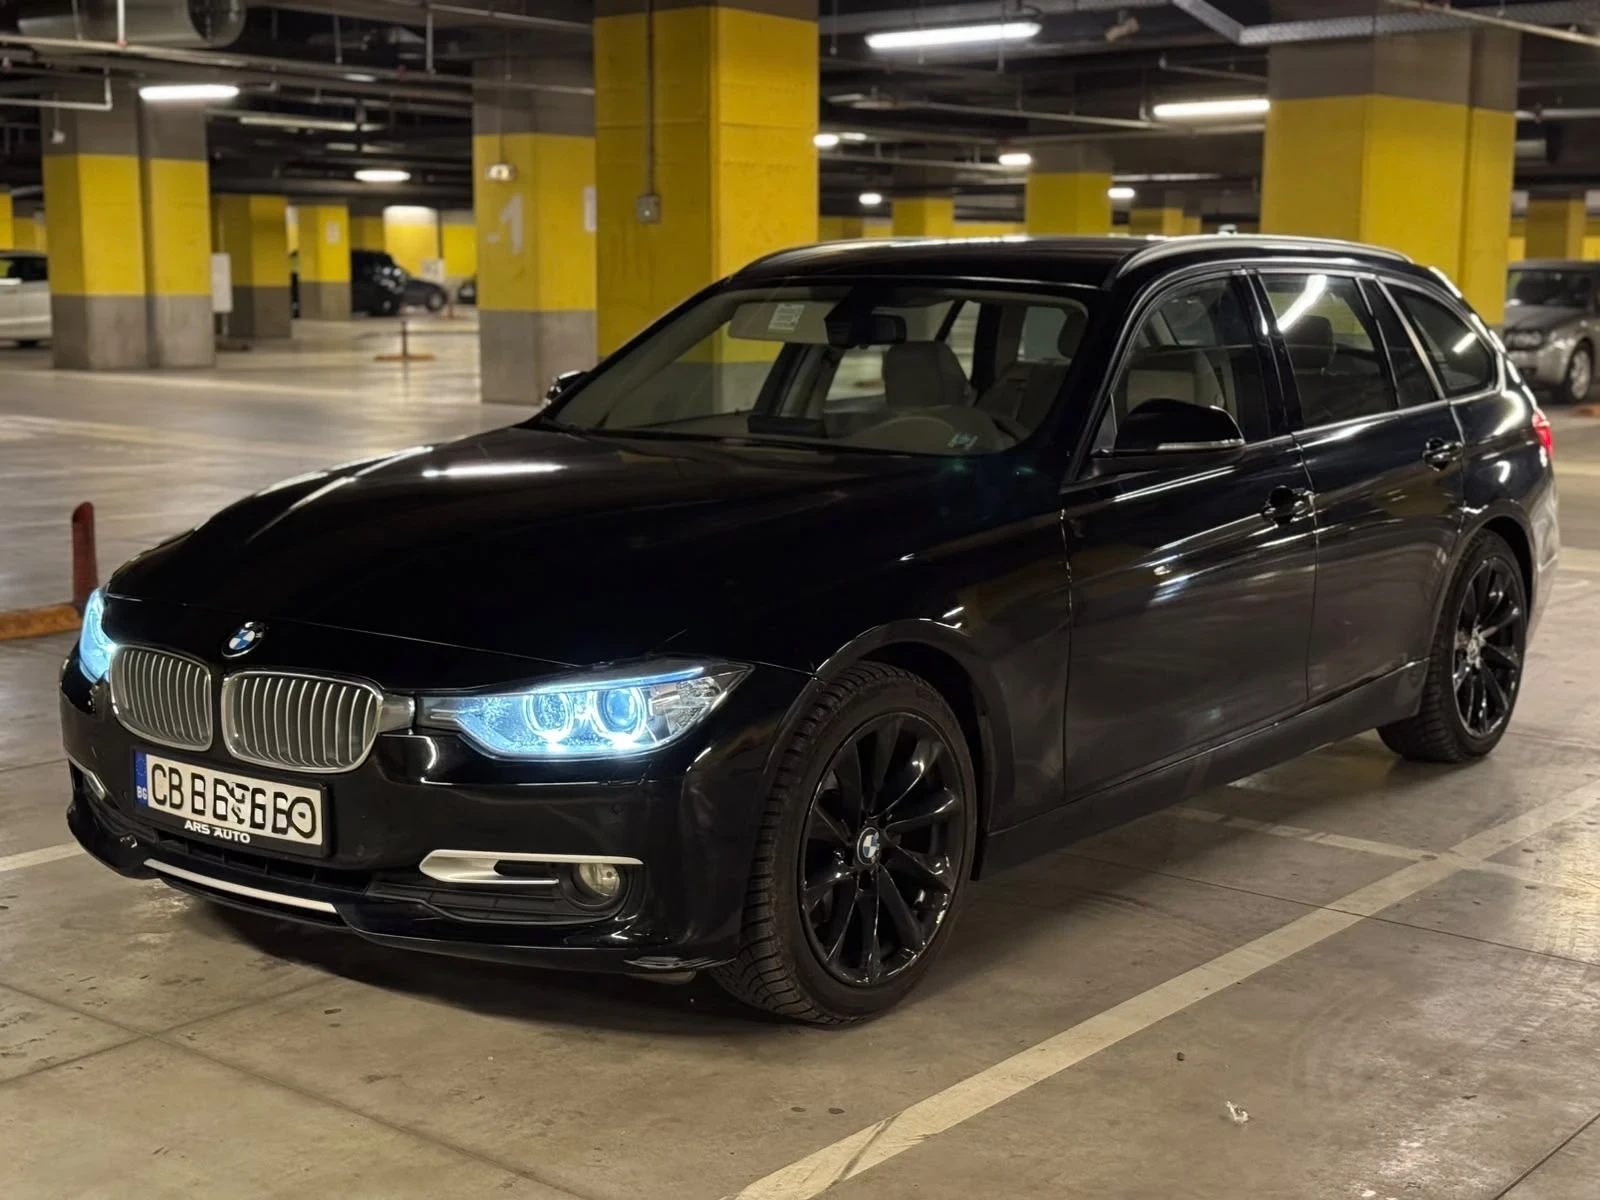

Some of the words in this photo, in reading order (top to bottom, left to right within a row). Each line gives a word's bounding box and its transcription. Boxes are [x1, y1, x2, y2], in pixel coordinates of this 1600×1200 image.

[136, 785, 148, 800] BG
[184, 820, 210, 835] ARS
[212, 827, 250, 844] AUTO
